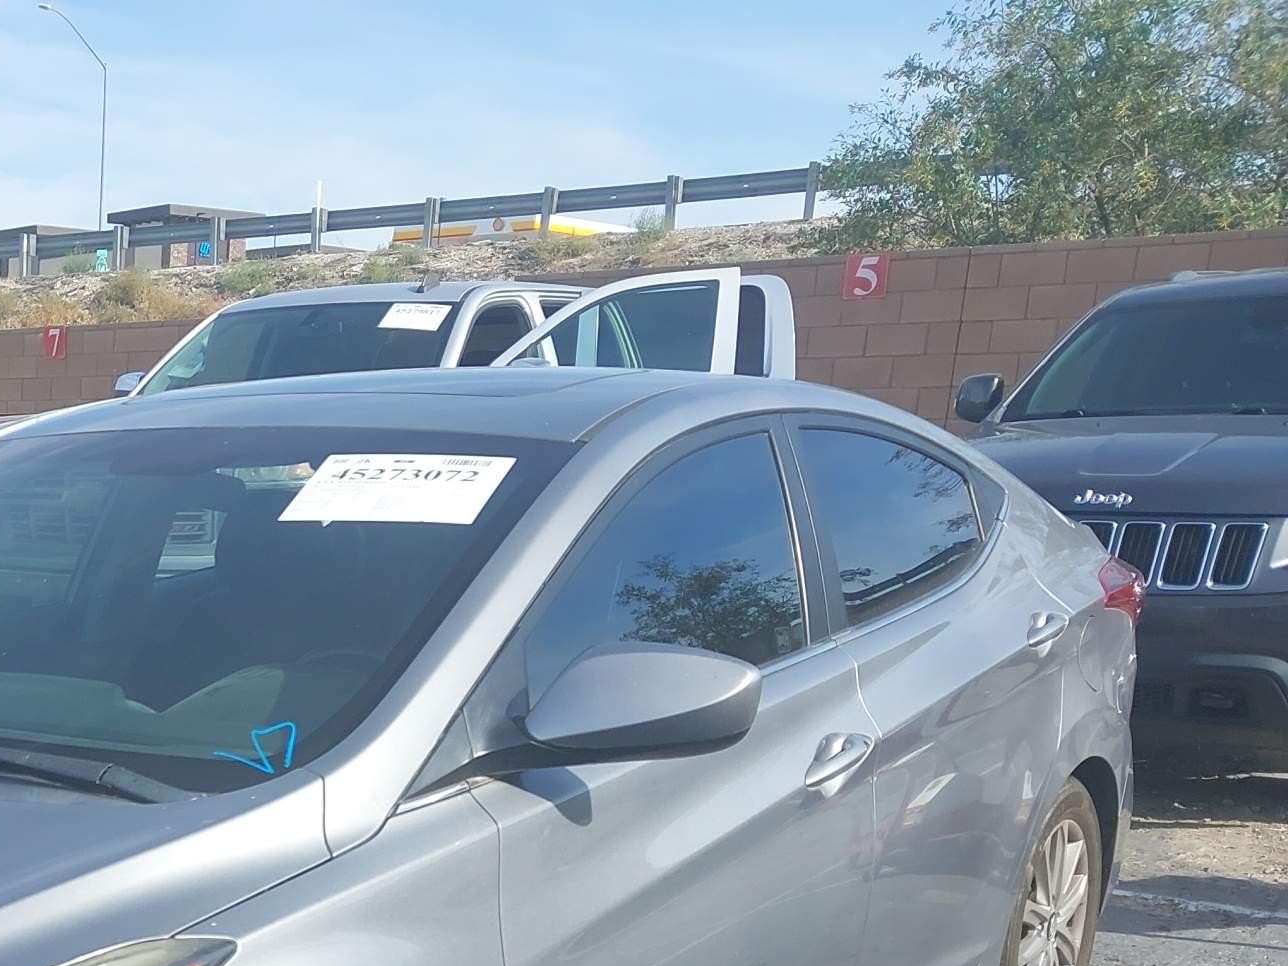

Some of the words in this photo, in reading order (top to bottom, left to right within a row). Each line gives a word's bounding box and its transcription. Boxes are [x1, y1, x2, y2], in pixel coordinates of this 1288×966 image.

[853, 256, 880, 296] 5
[48, 328, 61, 357] 7
[330, 467, 480, 484] 45273072
[1073, 489, 1133, 509] Jeep
